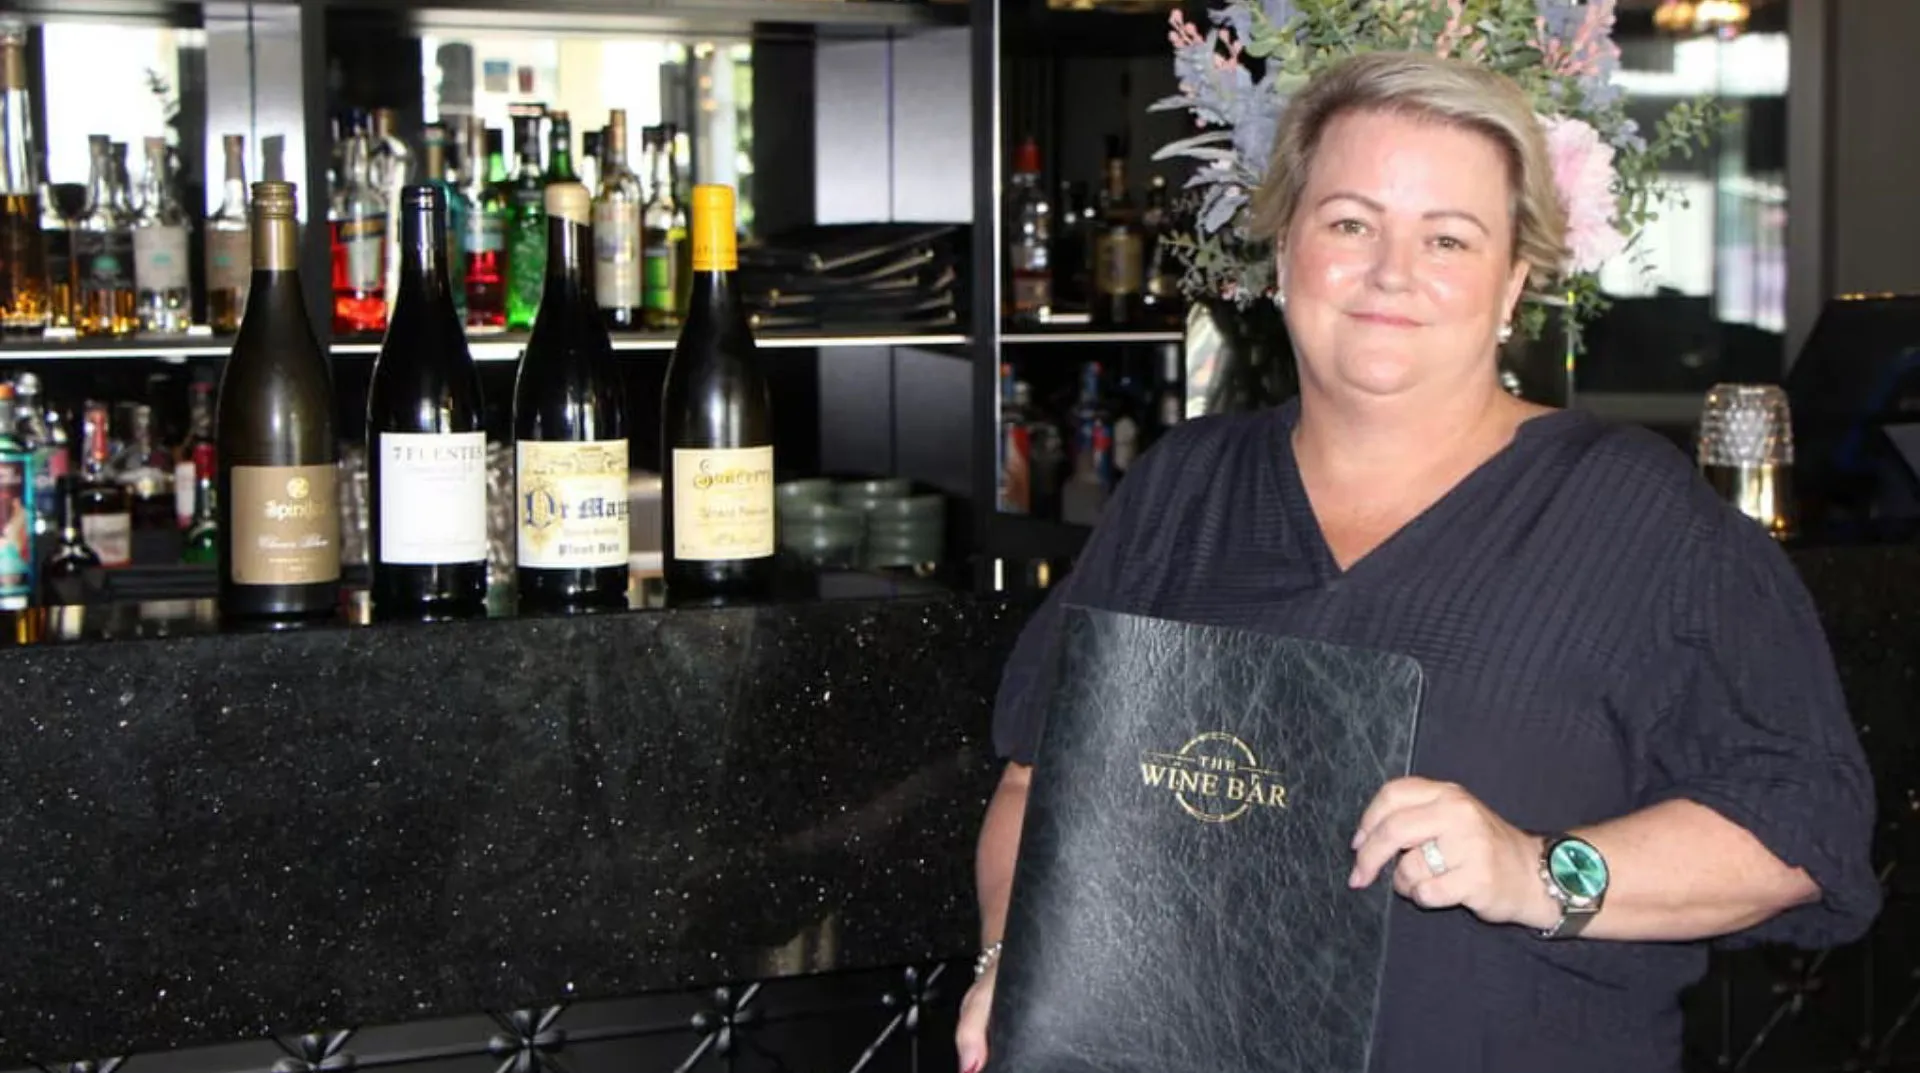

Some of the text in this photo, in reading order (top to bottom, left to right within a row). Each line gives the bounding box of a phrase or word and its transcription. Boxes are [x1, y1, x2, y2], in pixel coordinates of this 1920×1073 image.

[1200, 756, 1236, 772] THE
[1141, 763, 1287, 809] WINE BAR
